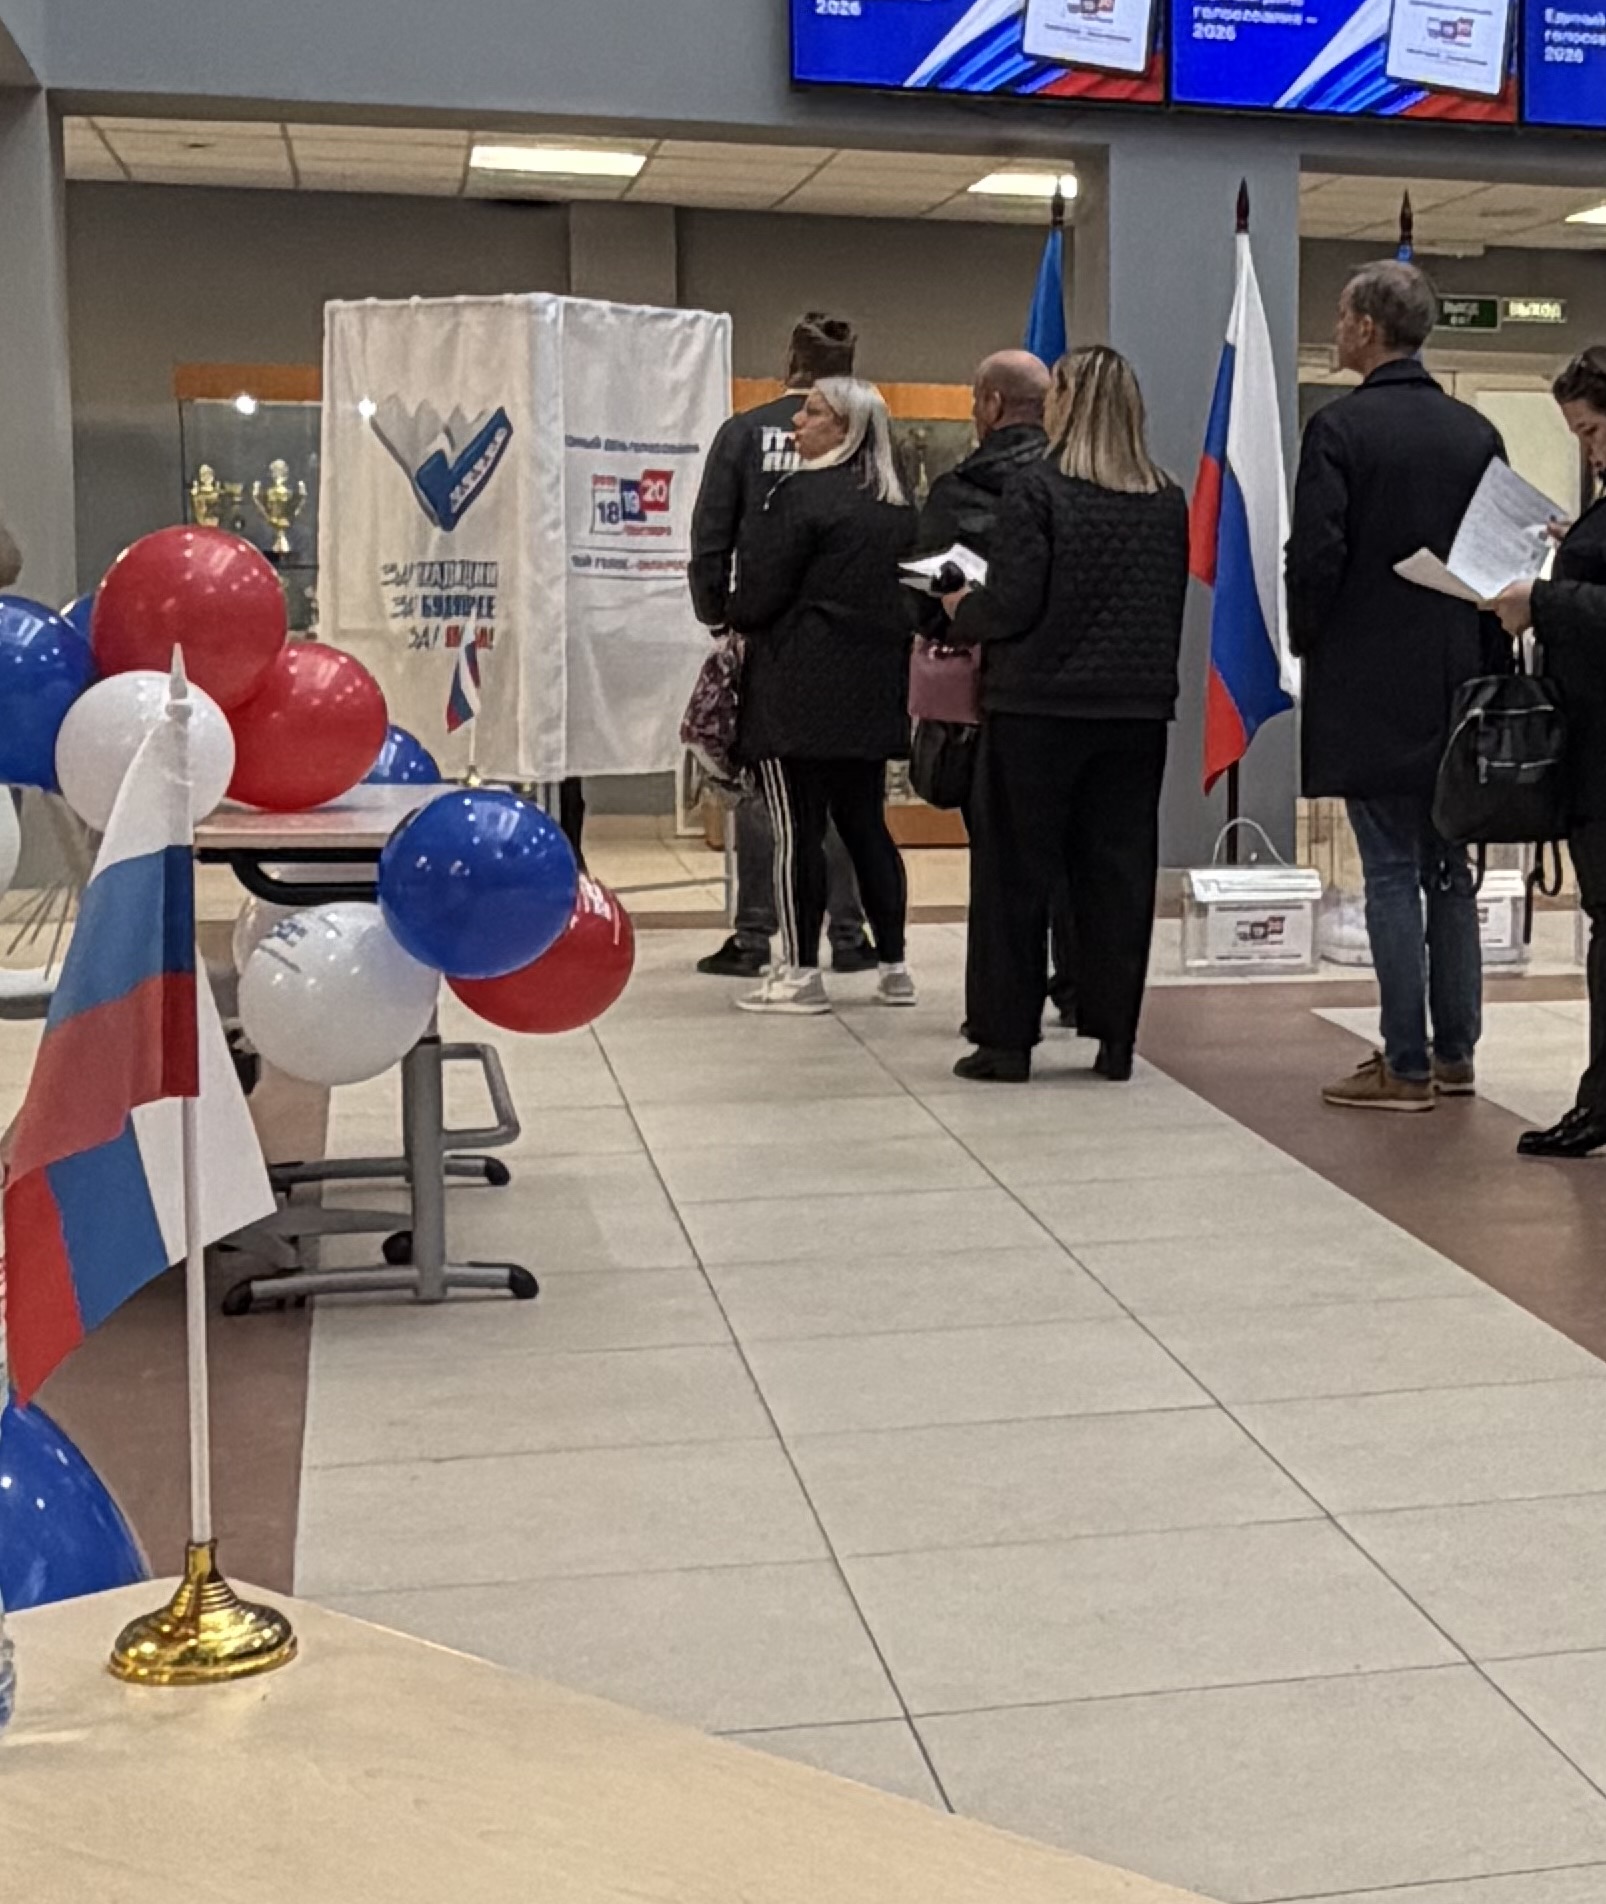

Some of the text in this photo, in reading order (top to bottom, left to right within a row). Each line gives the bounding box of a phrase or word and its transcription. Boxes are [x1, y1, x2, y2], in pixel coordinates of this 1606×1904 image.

[1193, 23, 1236, 41] 2026
[596, 501, 620, 525] 18
[642, 479, 668, 503] 20
